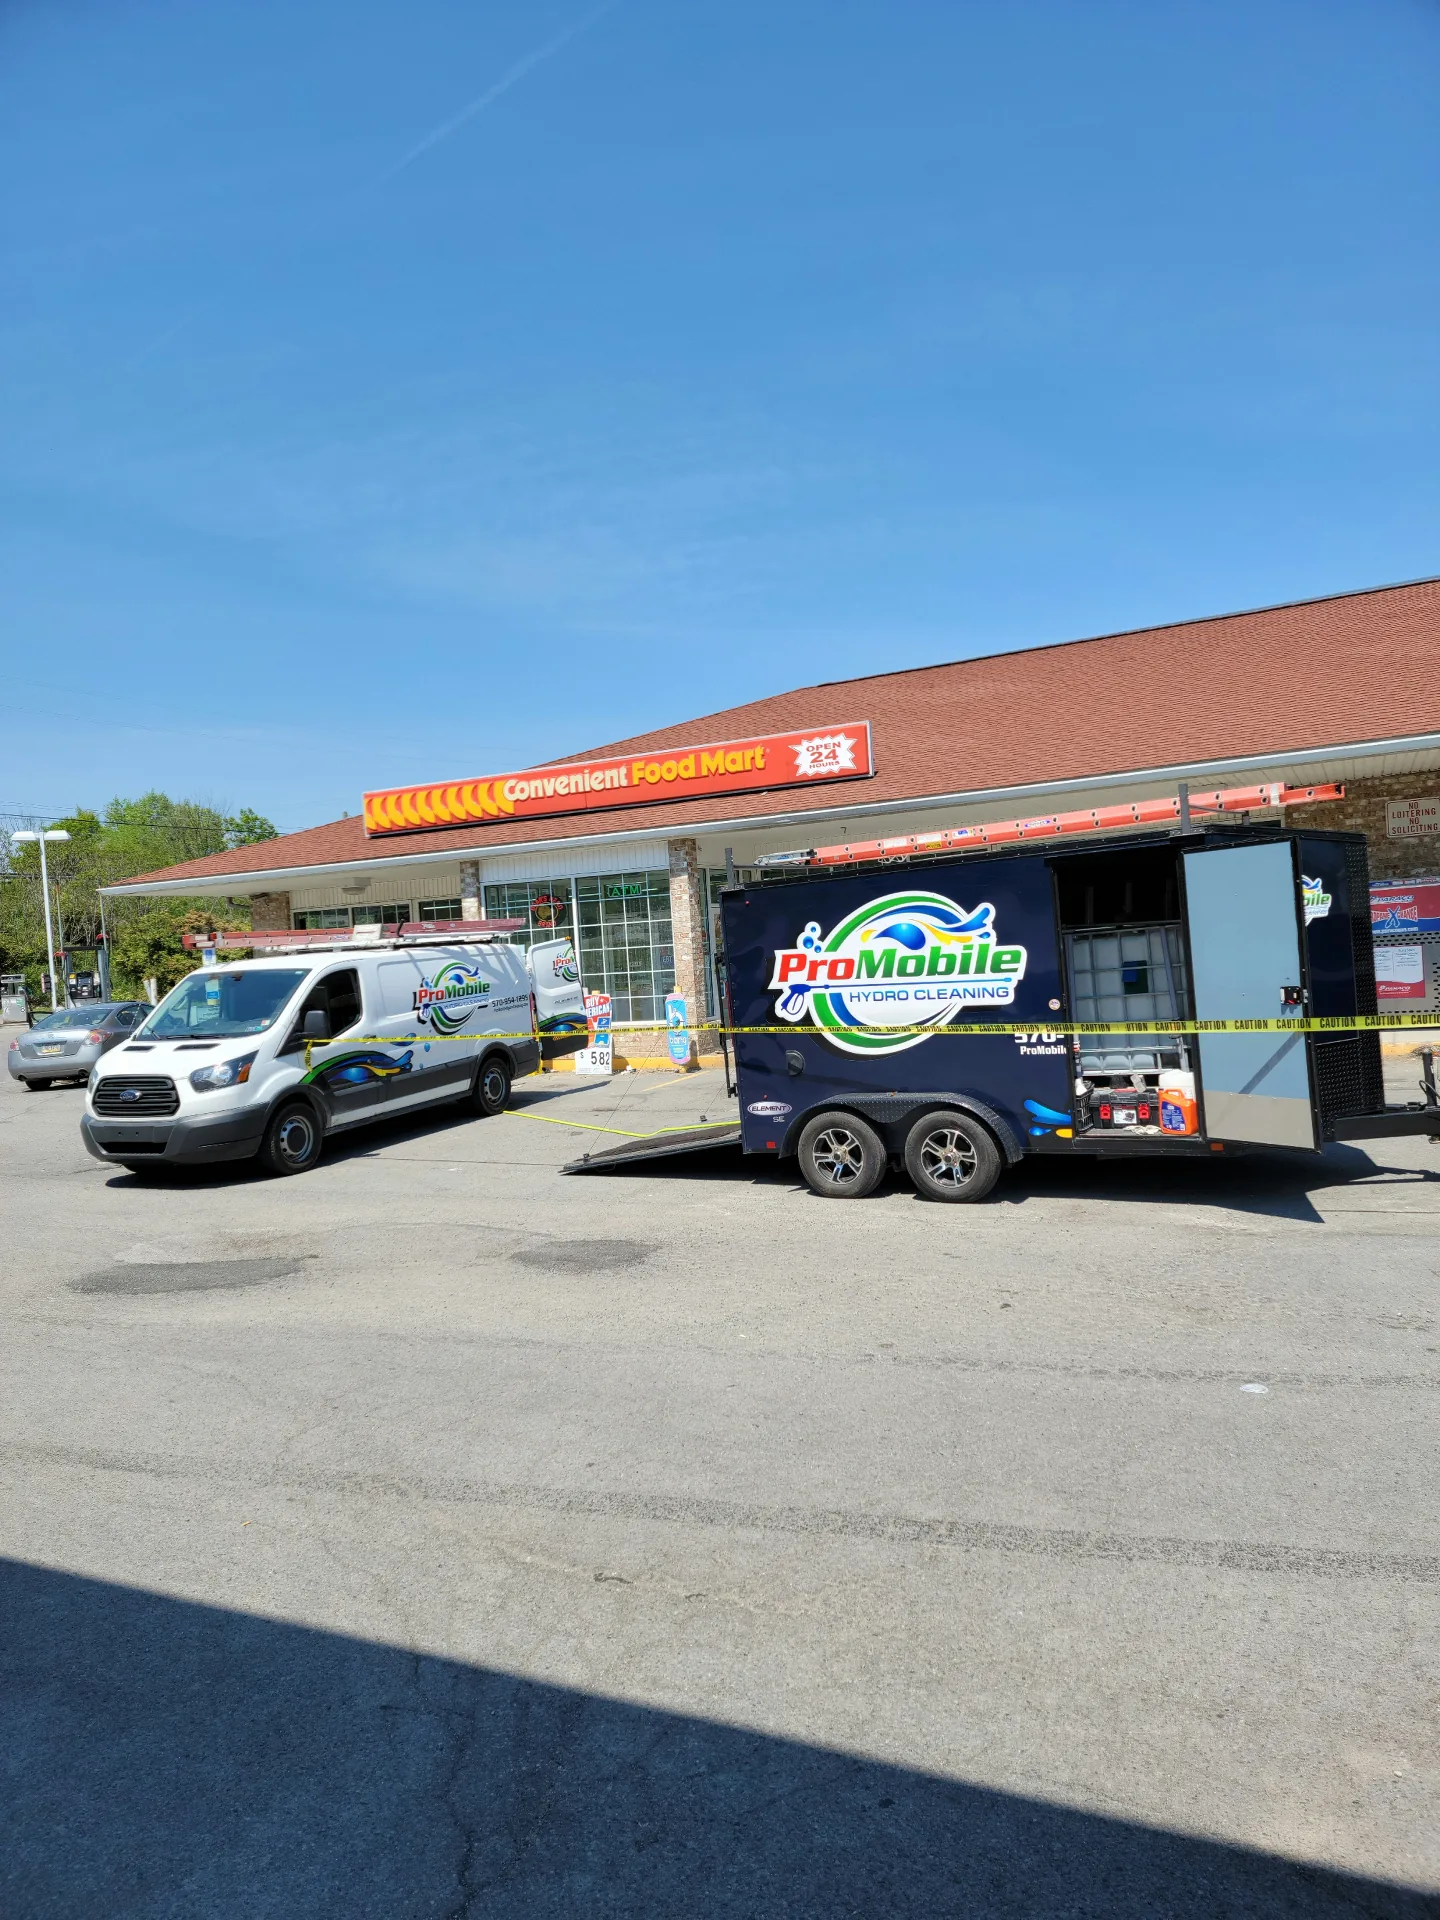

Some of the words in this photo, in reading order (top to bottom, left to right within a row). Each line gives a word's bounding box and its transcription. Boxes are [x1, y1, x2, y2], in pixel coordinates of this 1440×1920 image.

[806, 741, 841, 753] OPEN
[809, 750, 839, 763] 24
[809, 760, 841, 769] HOURS
[503, 765, 628, 801] Convenient
[632, 752, 695, 785] Food
[701, 744, 765, 776] Mart
[1408, 802, 1419, 810] NO
[1392, 808, 1436, 819] LOITERING
[1409, 817, 1420, 825] NO
[1391, 823, 1438, 834] SOLICITING
[611, 885, 640, 896] ATM
[777, 943, 1022, 983] ProMobile
[418, 981, 491, 1003] ProMobile
[849, 987, 909, 1003] HYDRO
[914, 985, 1009, 1002] CLEANING
[585, 994, 600, 1009] BUY
[586, 1002, 610, 1018] ERICAN
[979, 1024, 1006, 1032] CAUTION
[1012, 1024, 1040, 1032] CAUTION
[1045, 1024, 1075, 1032] CAUTION
[1081, 1023, 1111, 1032] CAUTION
[1122, 1022, 1148, 1032] UTION
[1155, 1021, 1187, 1031] CAUTION
[1194, 1020, 1227, 1030] CAUTION
[1234, 1019, 1268, 1030] CAUTION
[1276, 1017, 1311, 1029] CAUTION
[1319, 1016, 1356, 1028] CAUTION
[1364, 1015, 1401, 1026] CAUTION
[1410, 1013, 1440, 1024] CAUTIO
[772, 1115, 785, 1123] SE
